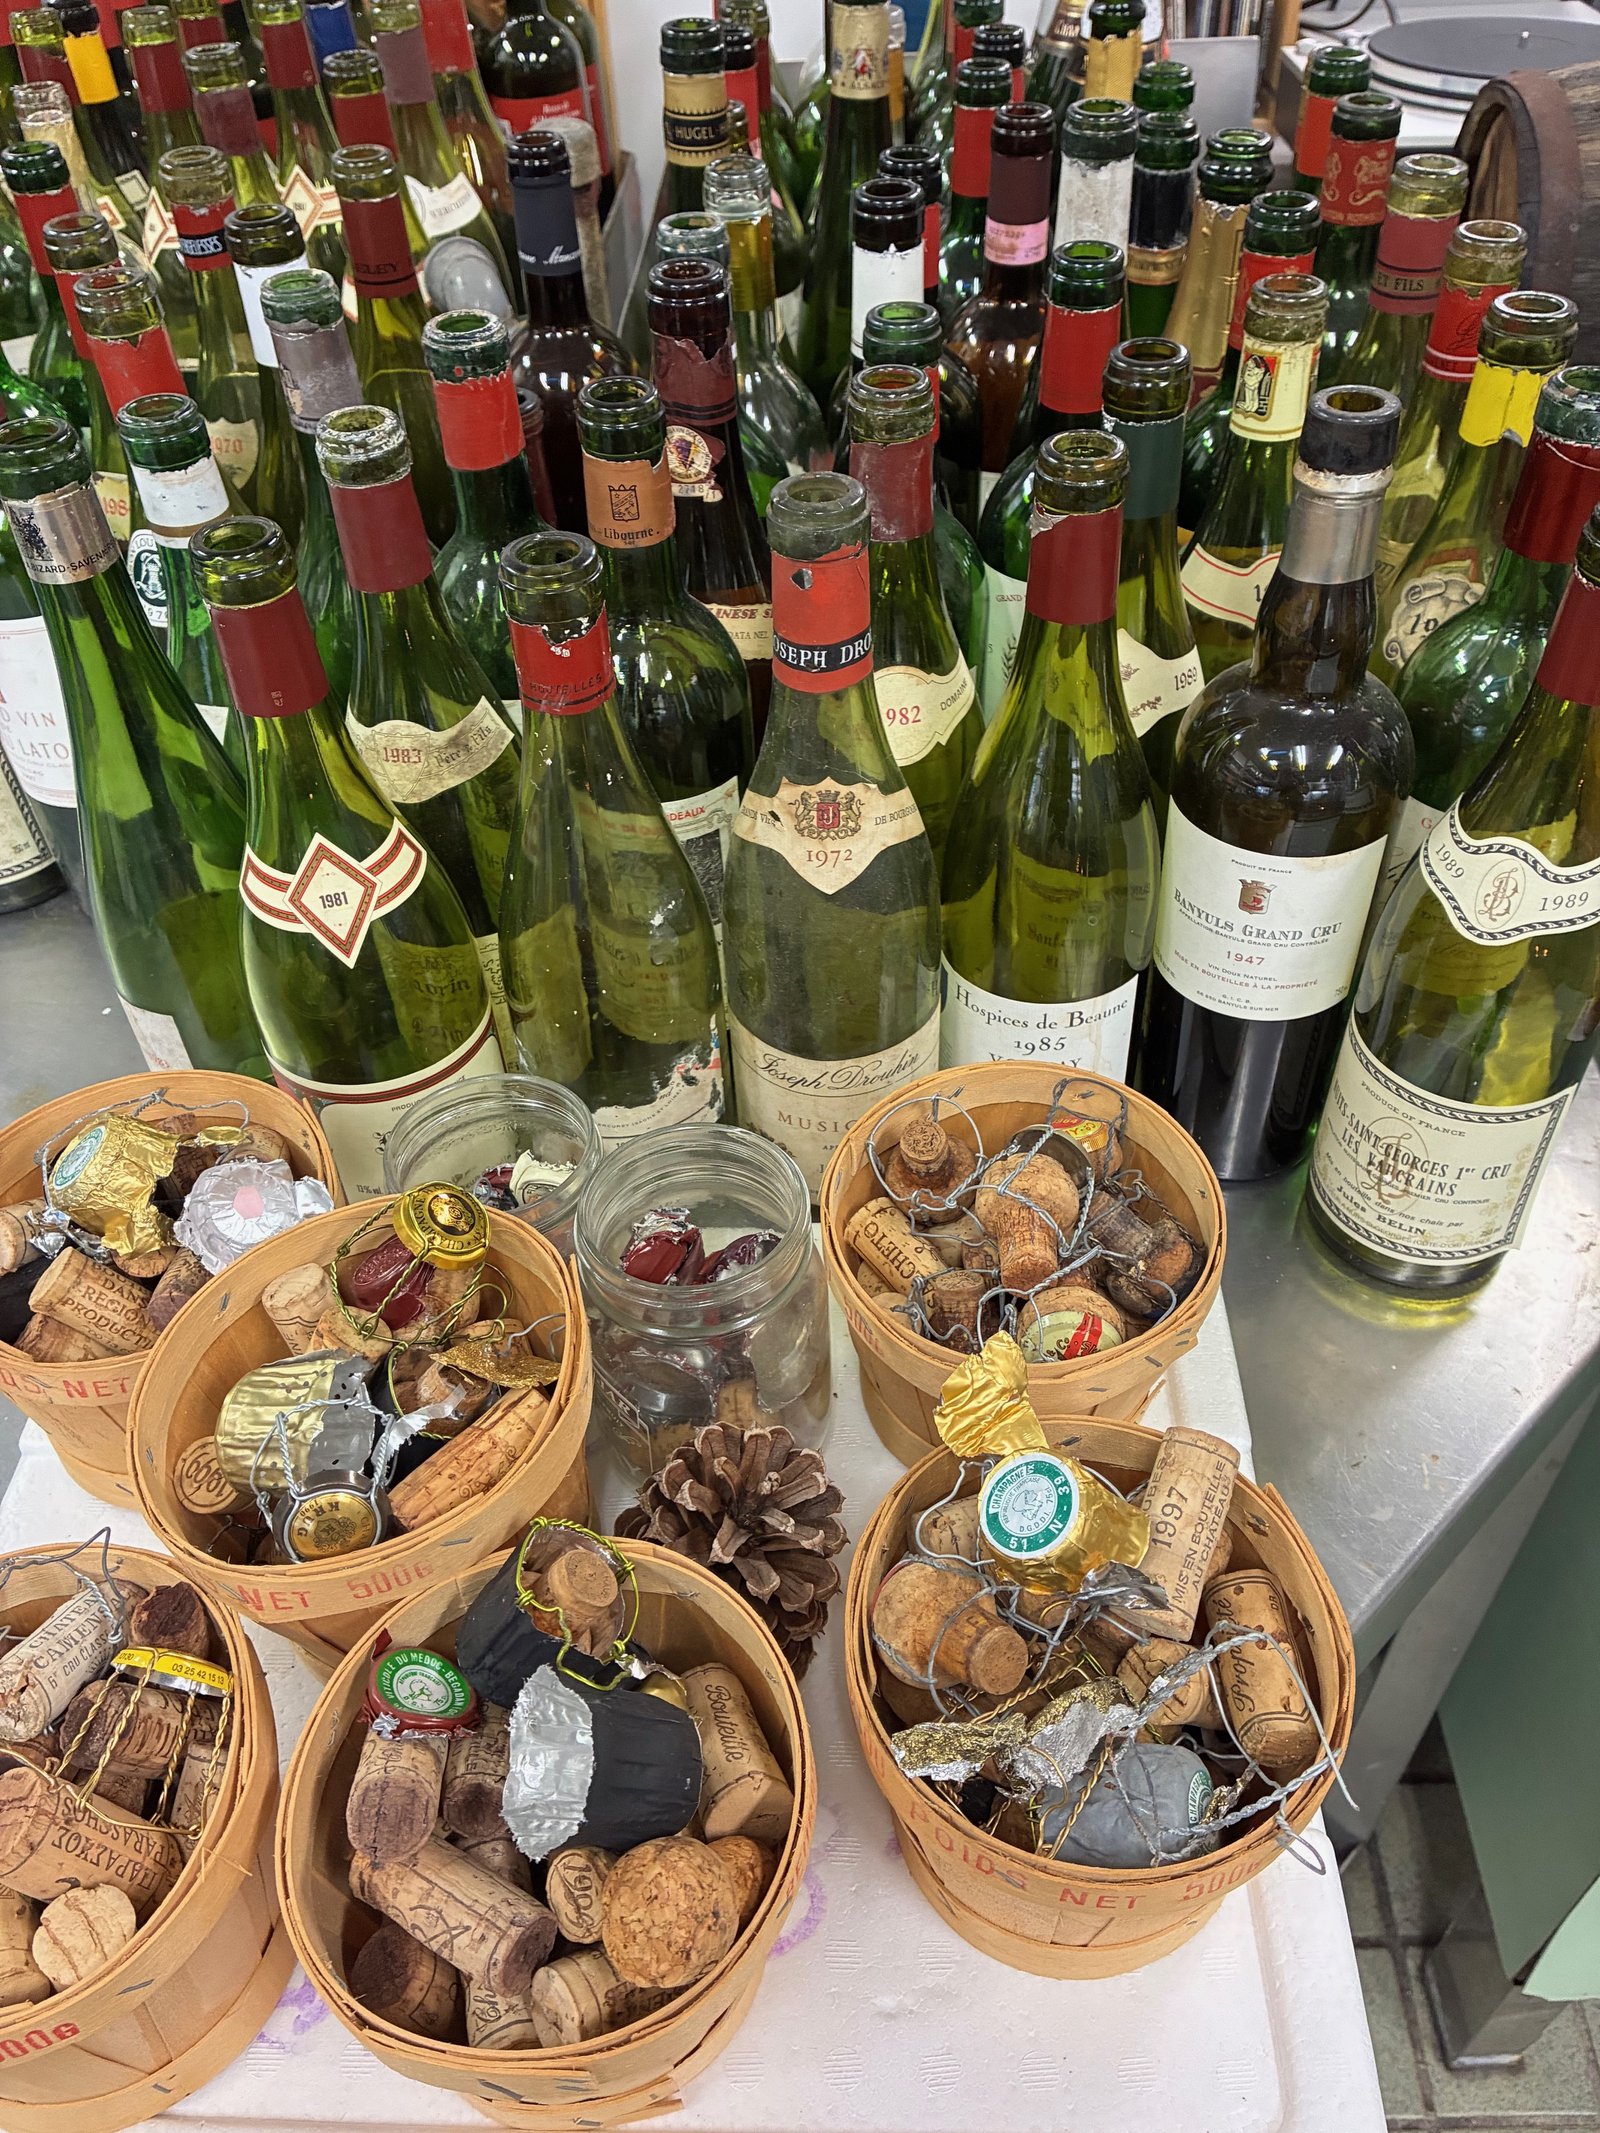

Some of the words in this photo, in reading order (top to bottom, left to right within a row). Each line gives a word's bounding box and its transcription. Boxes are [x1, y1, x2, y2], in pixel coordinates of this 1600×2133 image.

[674, 124, 716, 140] HUGEL
[1394, 277, 1425, 292] FILS
[103, 496, 130, 517] 198
[135, 537, 155, 549] LOU
[603, 526, 661, 542] Libourne.
[773, 634, 827, 669] OSEPH
[840, 631, 872, 666] DRO
[1173, 666, 1198, 691] 1989
[19, 712, 56, 728] VIN
[886, 705, 922, 726] 982
[470, 725, 493, 747] Fils
[19, 739, 70, 760] LATO
[383, 747, 423, 764] 1983
[666, 806, 706, 822] DEAUX
[874, 815, 888, 826] DE
[806, 848, 853, 868] 1972
[1435, 843, 1466, 879] 1989
[319, 891, 350, 910] 1981
[1537, 891, 1590, 912] 1989
[1174, 887, 1235, 933] BANYULS
[1241, 923, 1304, 942] GRAND
[1310, 921, 1344, 940] CRU
[1214, 930, 1246, 944] BANYULS
[1246, 939, 1273, 948] GRAND
[1173, 949, 1189, 966] MISE
[1189, 960, 1200, 973] EN
[1200, 968, 1250, 988] BOUTEILLES
[1225, 950, 1266, 966] 1947
[1208, 962, 1220, 971] VIN
[1221, 967, 1242, 978] DOUX
[1243, 972, 1278, 982] NATUREL
[954, 984, 1030, 1031] Hospices
[1035, 1012, 1059, 1031] de
[1064, 999, 1130, 1029] Beaune
[1217, 998, 1248, 1010] BANYULS
[1013, 1035, 1067, 1057] 1985
[753, 1052, 824, 1091] Joseph
[828, 1050, 921, 1091] Drouhin
[390, 1099, 422, 1112] PRODU
[1361, 1080, 1400, 1115] PRODUCE
[1401, 1111, 1416, 1123] OF
[1418, 1119, 1467, 1138] FRANCE
[1341, 1126, 1361, 1155] LES
[1481, 1163, 1513, 1180] CRU
[1336, 1184, 1368, 1213] Jules
[1376, 1214, 1427, 1236] BELIN
[1374, 1200, 1396, 1214] dans
[1398, 1211, 1417, 1221] nos
[1419, 1218, 1445, 1227] chais
[1446, 1221, 1465, 1229] par
[102, 1272, 149, 1310] DANS
[61, 1297, 155, 1350] PRODUCTI
[62, 1376, 131, 1399] NET
[991, 1465, 1027, 1510] CHAMPAGNE
[1189, 1458, 1227, 1548] BOUTEILLE
[296, 1500, 341, 1538] KRUG
[1151, 1485, 1189, 1549] 1997
[1009, 1537, 1028, 1550] 51
[1048, 1518, 1064, 1535] N
[1180, 1547, 1198, 1572] EN
[1172, 1568, 1190, 1604] MIS
[1192, 1568, 1205, 1593] AU
[236, 1584, 313, 1612] NET
[28, 1594, 101, 1650] CHATEA
[62, 1654, 81, 1677] CRU
[394, 1653, 409, 1667] DU
[410, 1651, 444, 1671] MEDOC
[171, 1663, 184, 1673] 03
[184, 1666, 196, 1676] 25
[196, 1669, 207, 1680] 42
[207, 1672, 217, 1682] 15
[216, 1674, 226, 1685] 13
[1058, 1887, 1147, 1910] NET
